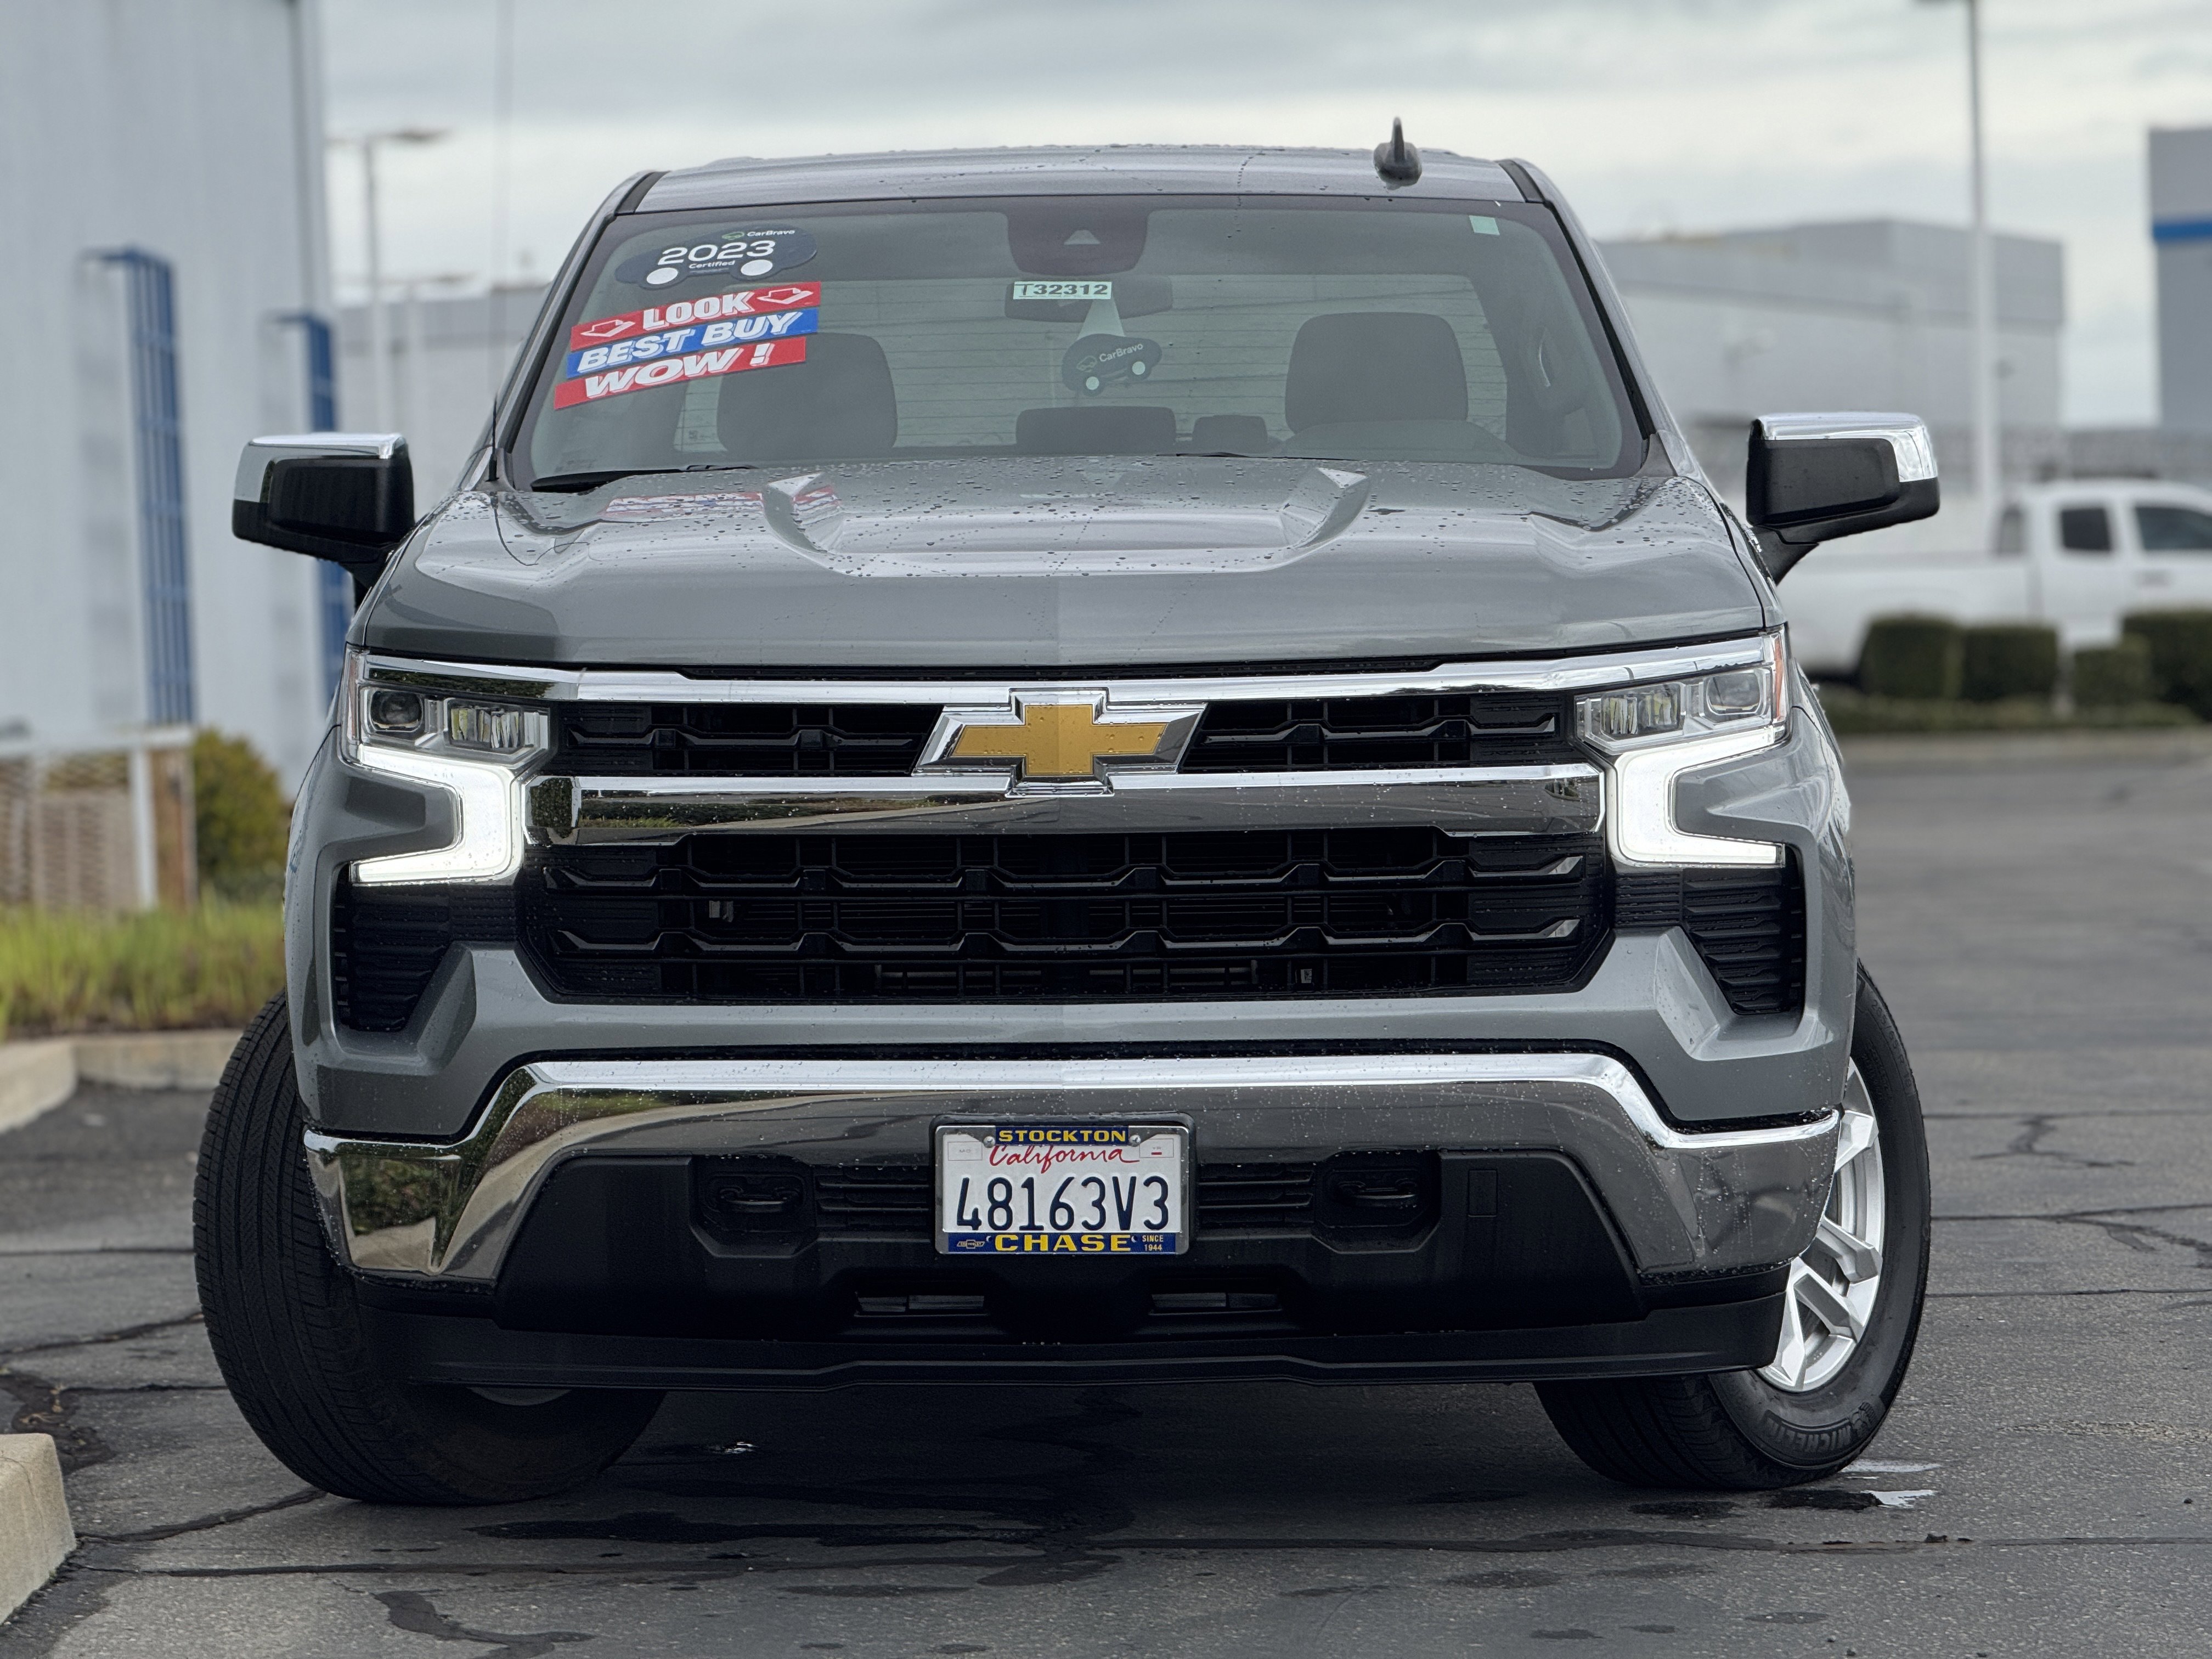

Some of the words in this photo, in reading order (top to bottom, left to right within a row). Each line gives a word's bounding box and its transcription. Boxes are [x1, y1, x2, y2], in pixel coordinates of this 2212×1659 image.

[657, 240, 776, 266] 2023
[689, 260, 736, 269] Certified
[1015, 284, 1108, 296] T32312
[642, 291, 754, 331] LOOK
[577, 329, 695, 373] BEST
[701, 312, 803, 346] BUY
[1099, 343, 1143, 362] CarBravo
[585, 347, 743, 399] WOW
[998, 1130, 1126, 1142] STOCKTON
[989, 1145, 1140, 1173] California
[956, 1176, 1169, 1231] 48163V3
[995, 1234, 1132, 1251] CHASE
